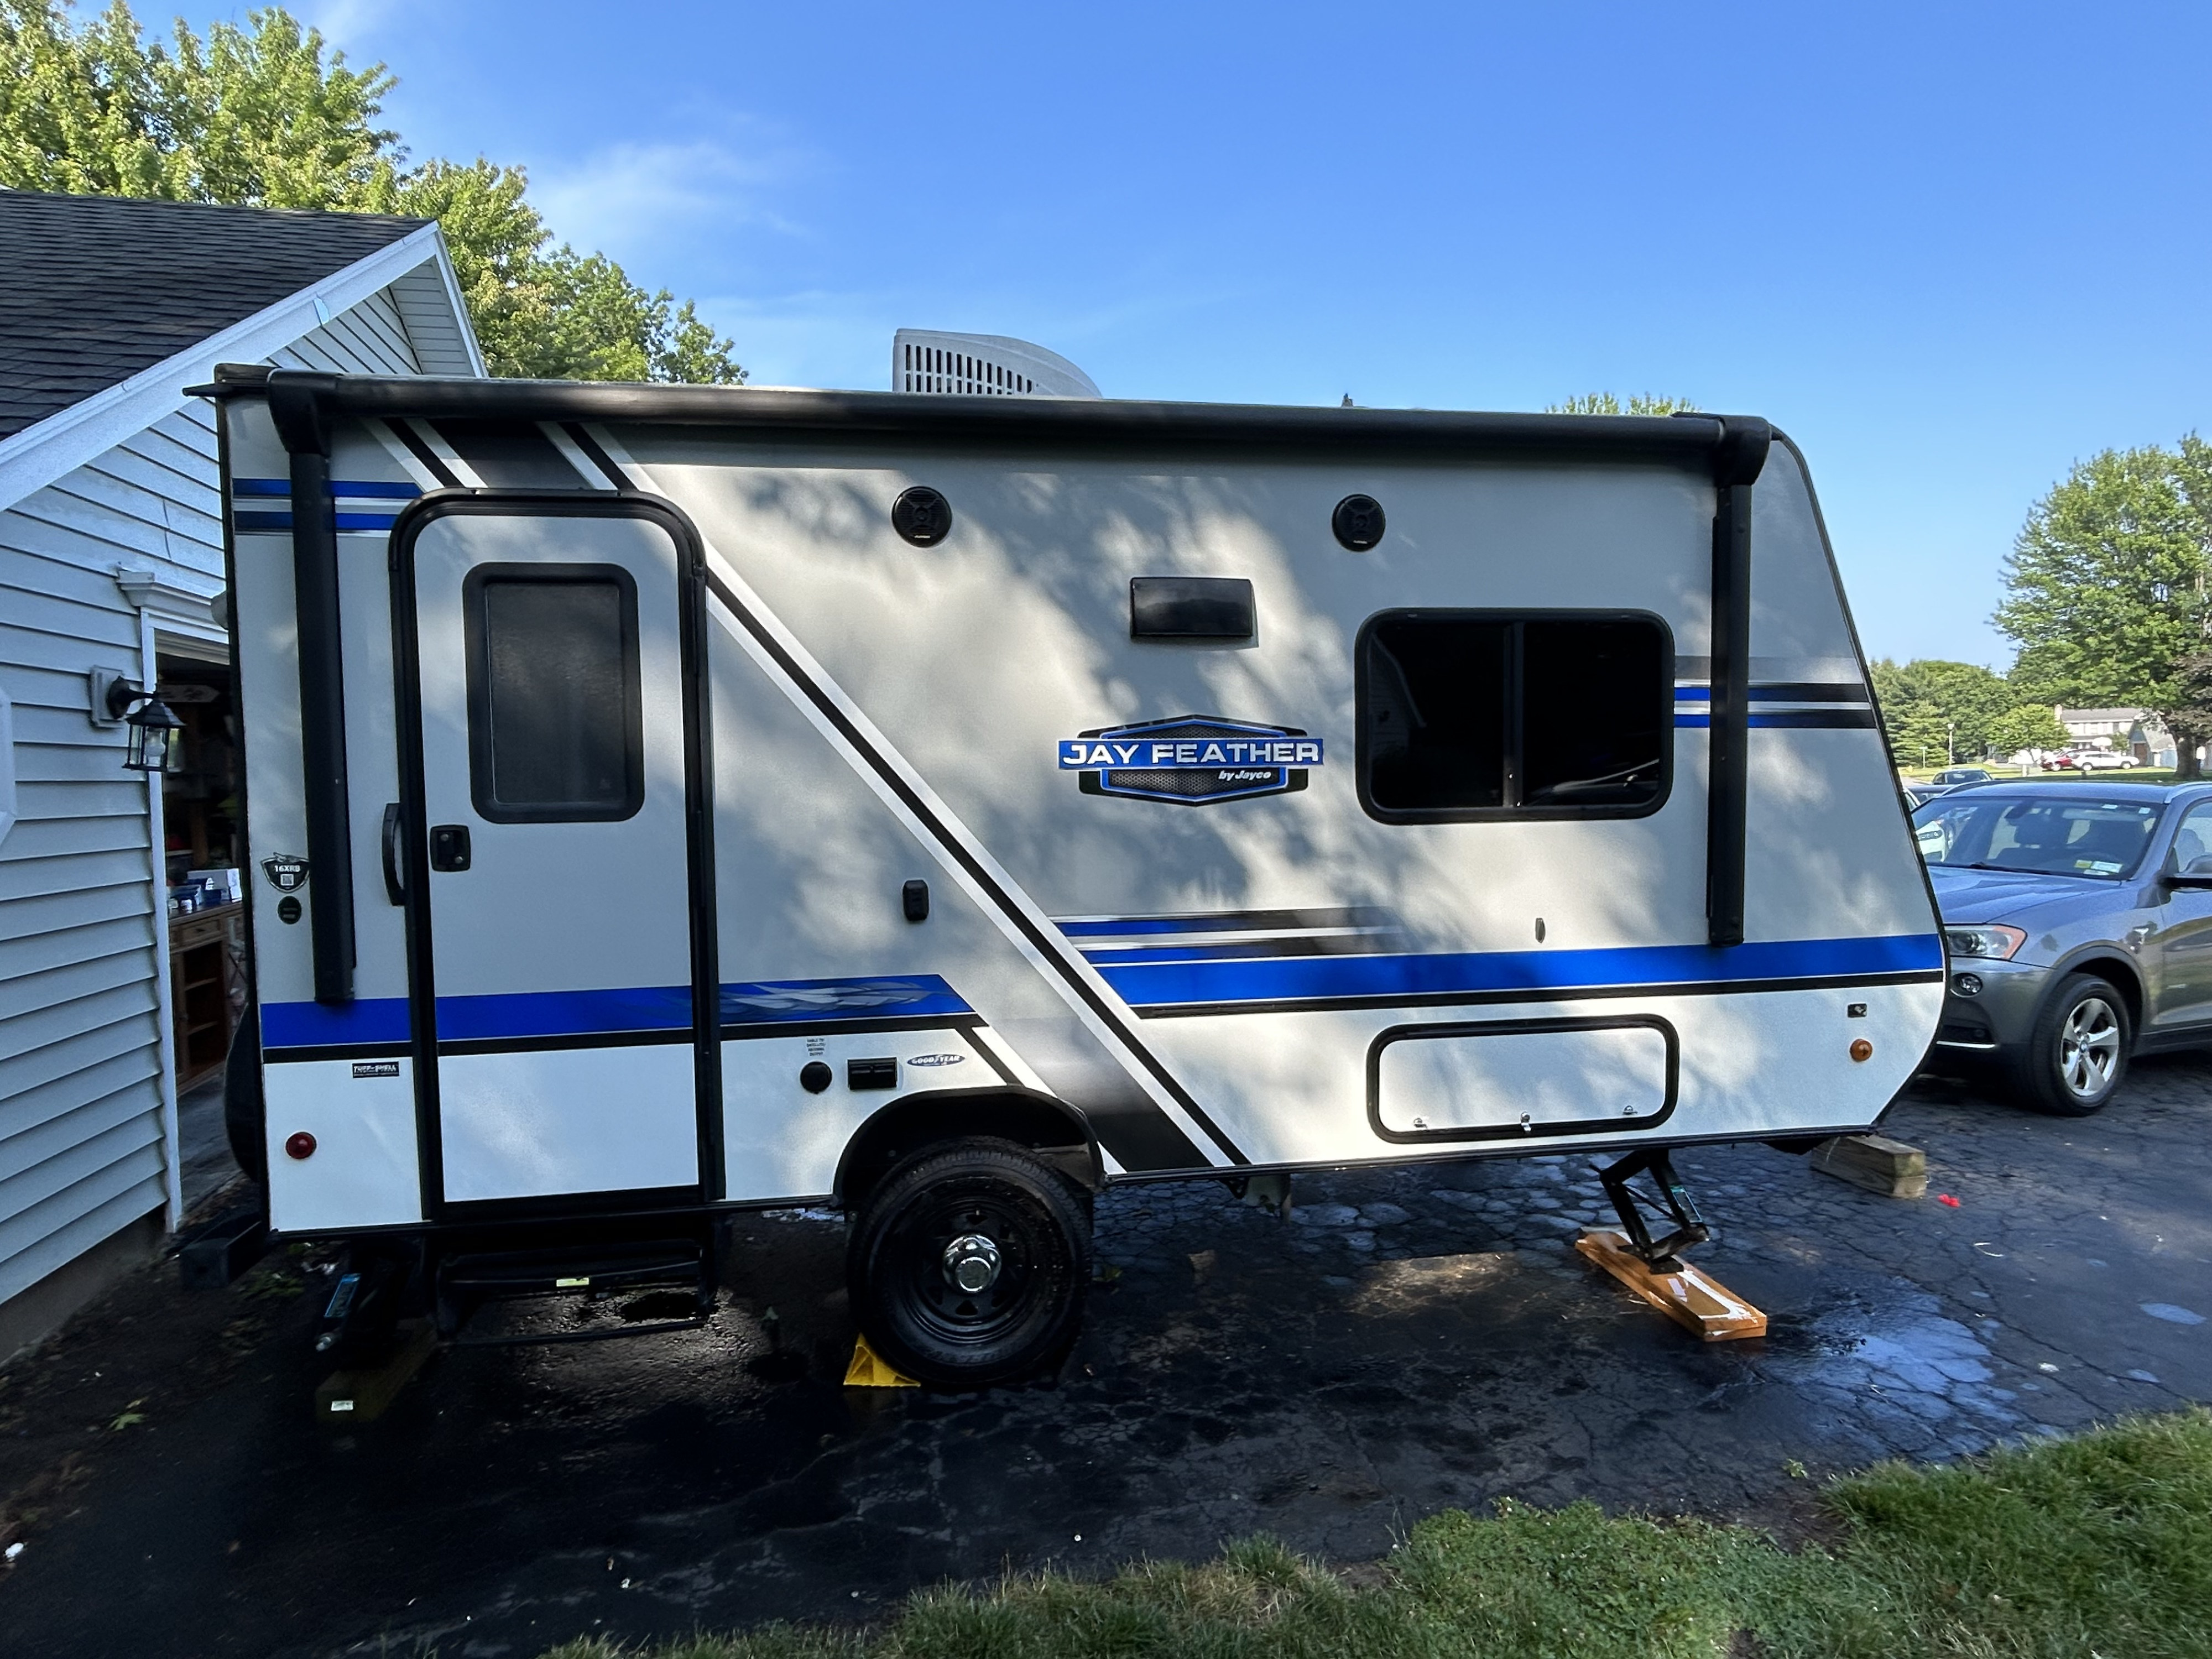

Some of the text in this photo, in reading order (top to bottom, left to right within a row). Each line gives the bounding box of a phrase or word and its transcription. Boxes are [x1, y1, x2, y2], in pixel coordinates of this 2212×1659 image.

[1063, 743, 1319, 765] JAY FEATHER
[1218, 769, 1272, 781] by Jayco
